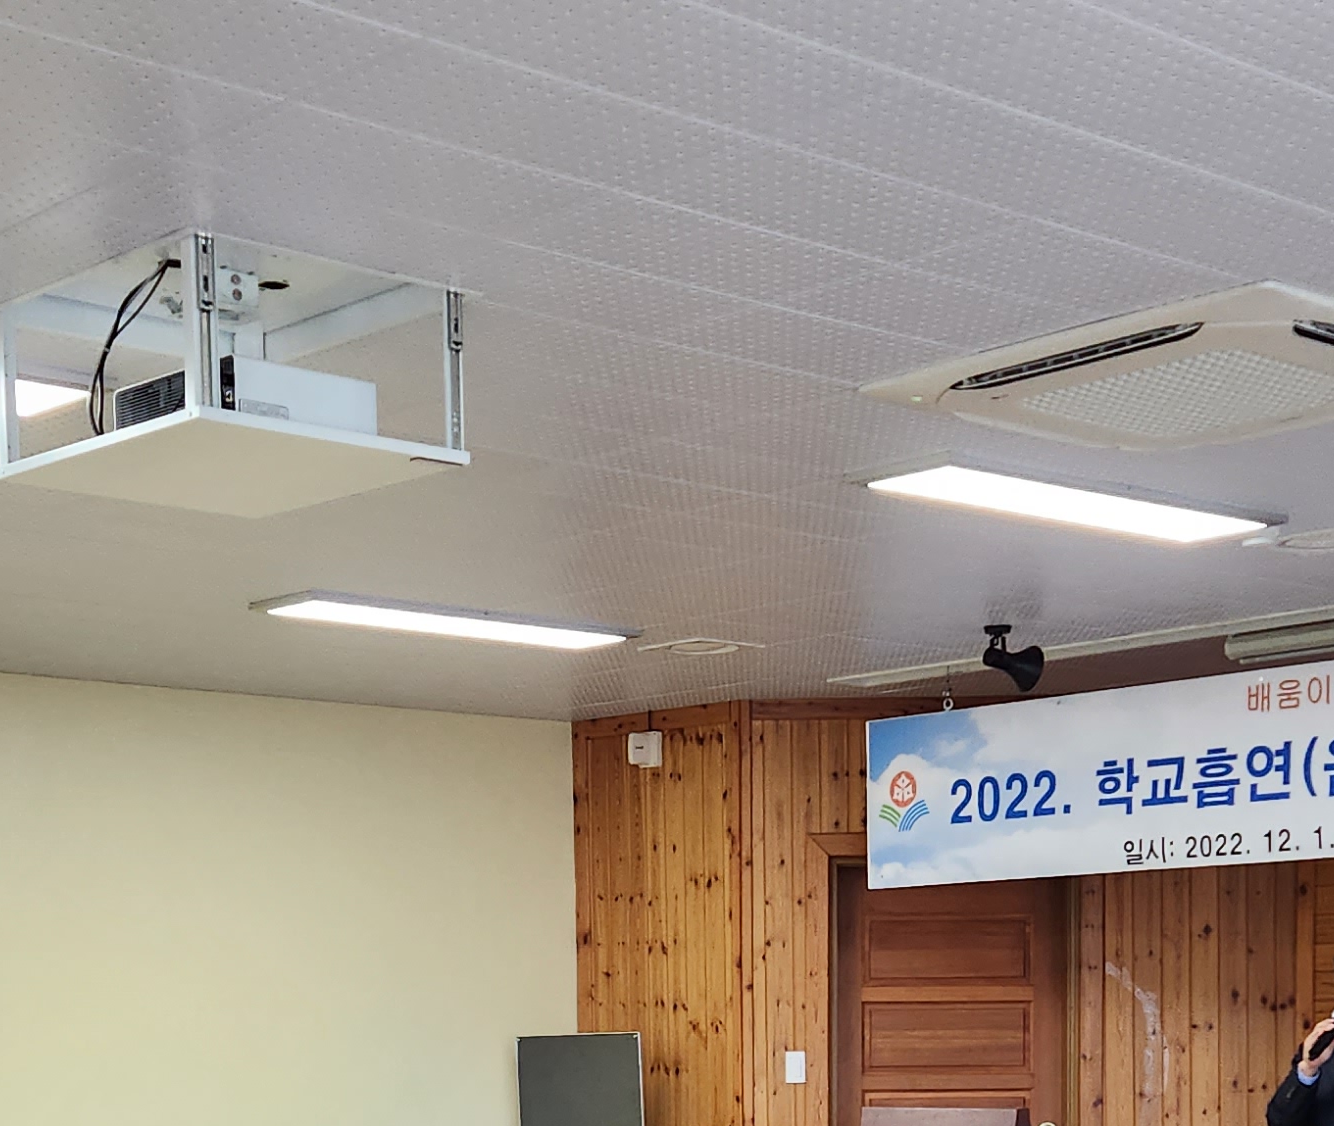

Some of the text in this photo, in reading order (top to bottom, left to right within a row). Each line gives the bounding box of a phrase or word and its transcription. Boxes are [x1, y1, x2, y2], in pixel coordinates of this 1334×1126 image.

[1246, 674, 1331, 712] 배움이
[948, 770, 1072, 826] 2022.
[1123, 836, 1175, 866] 일시:
[1185, 832, 1251, 859] 2022.
[1264, 828, 1300, 854] 12.
